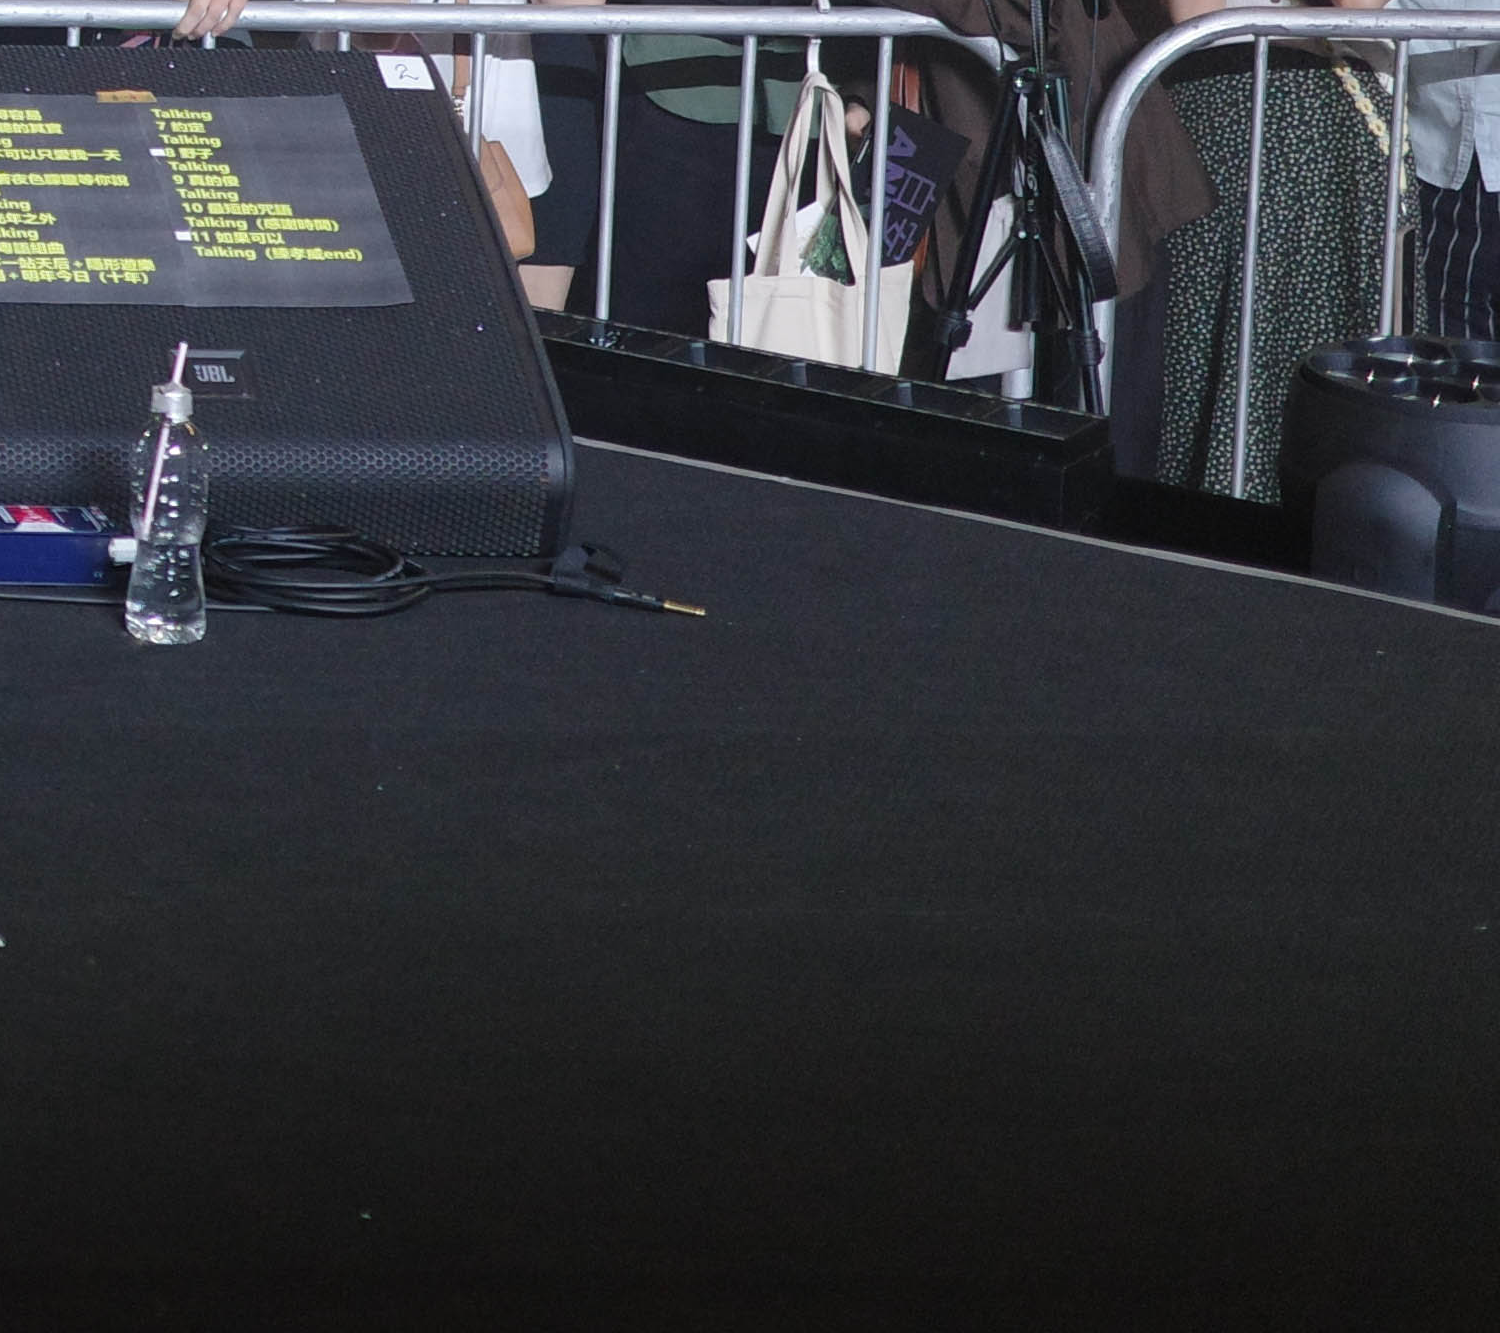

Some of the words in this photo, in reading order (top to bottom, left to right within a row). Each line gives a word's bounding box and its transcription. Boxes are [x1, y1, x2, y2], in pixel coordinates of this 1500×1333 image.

[150, 108, 213, 121] Talking
[158, 134, 222, 148] Talking
[167, 161, 231, 175] Talking
[176, 189, 239, 202] Talking
[215, 231, 286, 246] 如果可以
[195, 365, 235, 383] JBL
